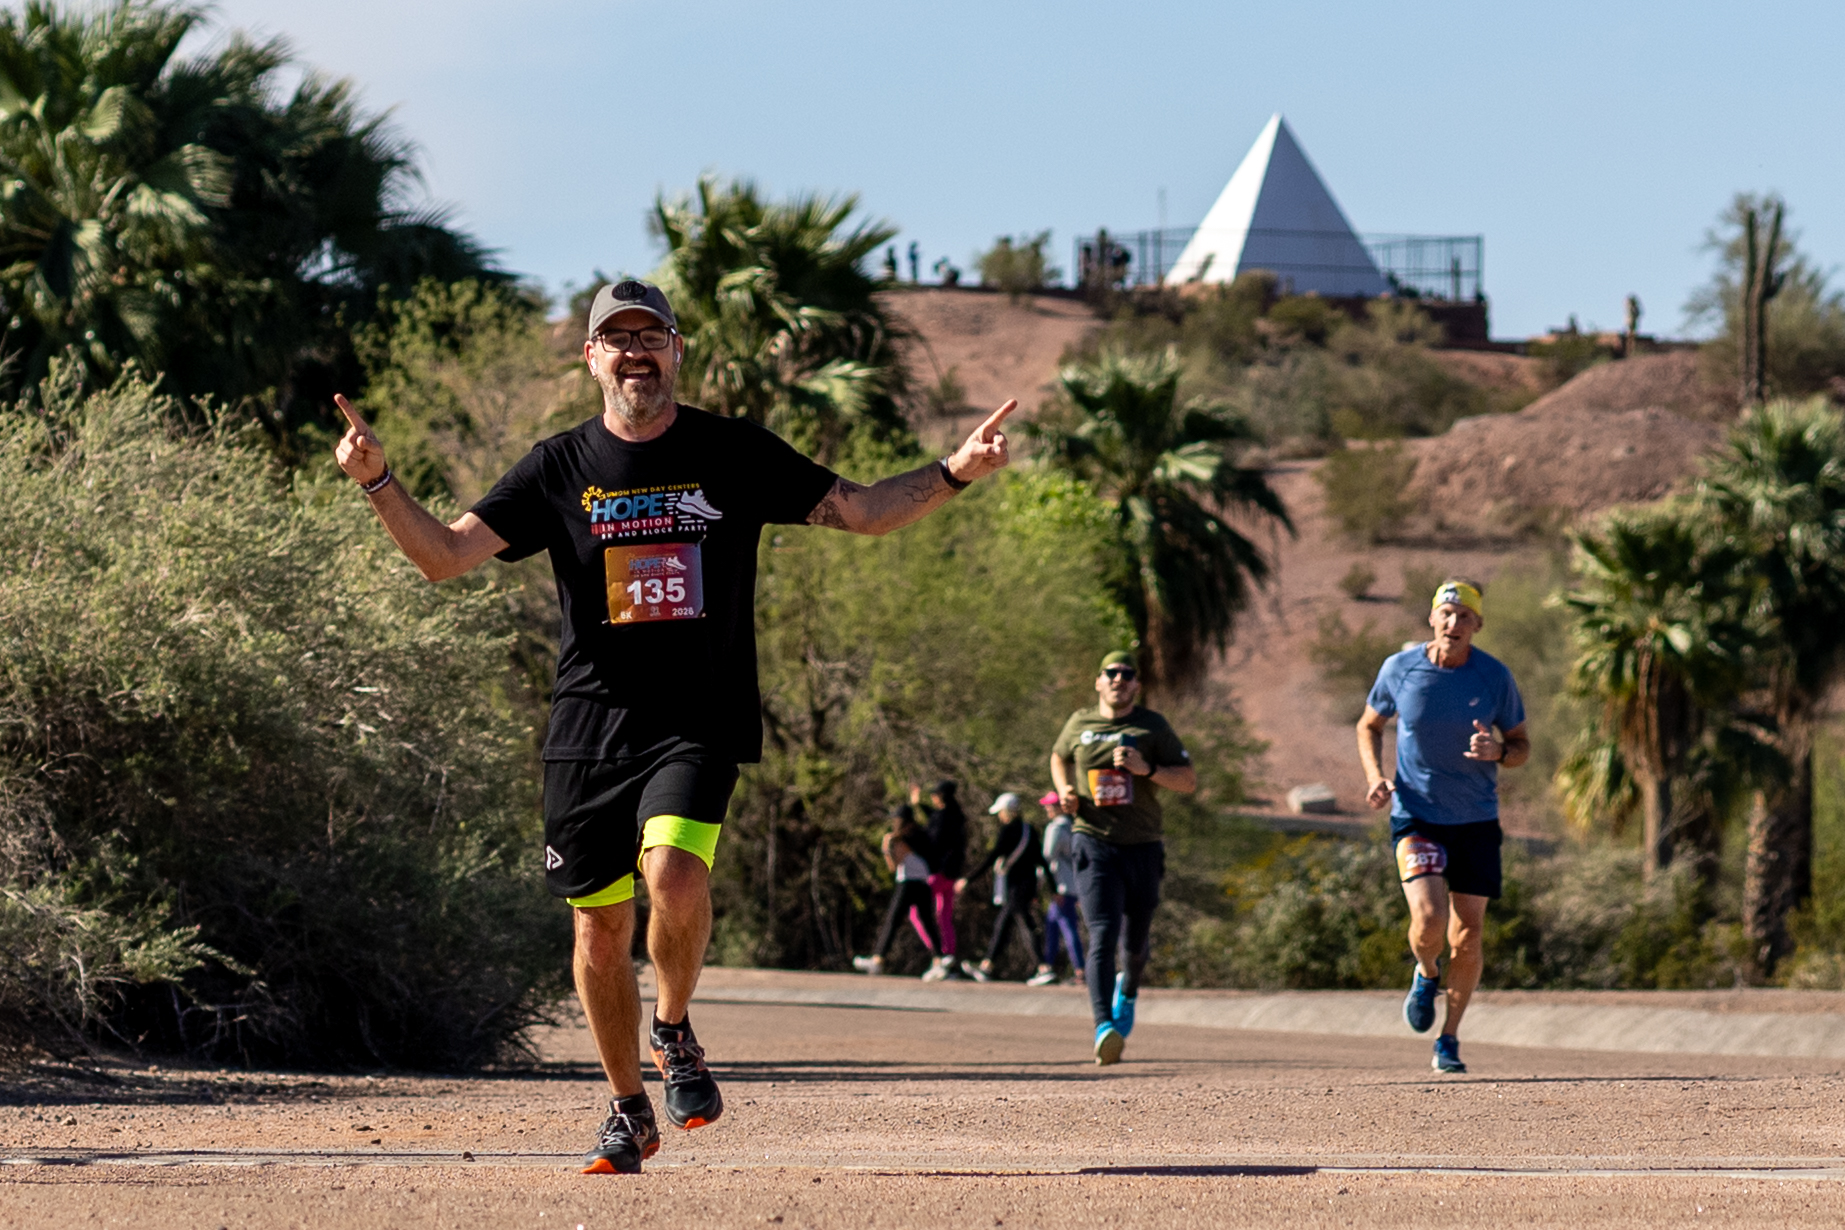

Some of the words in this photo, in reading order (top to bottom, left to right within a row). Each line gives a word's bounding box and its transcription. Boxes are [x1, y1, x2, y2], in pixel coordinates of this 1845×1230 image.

[667, 483, 700, 491] CENTERS
[591, 493, 664, 523] HOPE
[601, 523, 615, 533] IN
[622, 517, 673, 529] MOTION
[618, 530, 637, 538] AND
[642, 527, 673, 535] BLOCK
[627, 577, 686, 605] 135
[1405, 852, 1439, 870] 287
